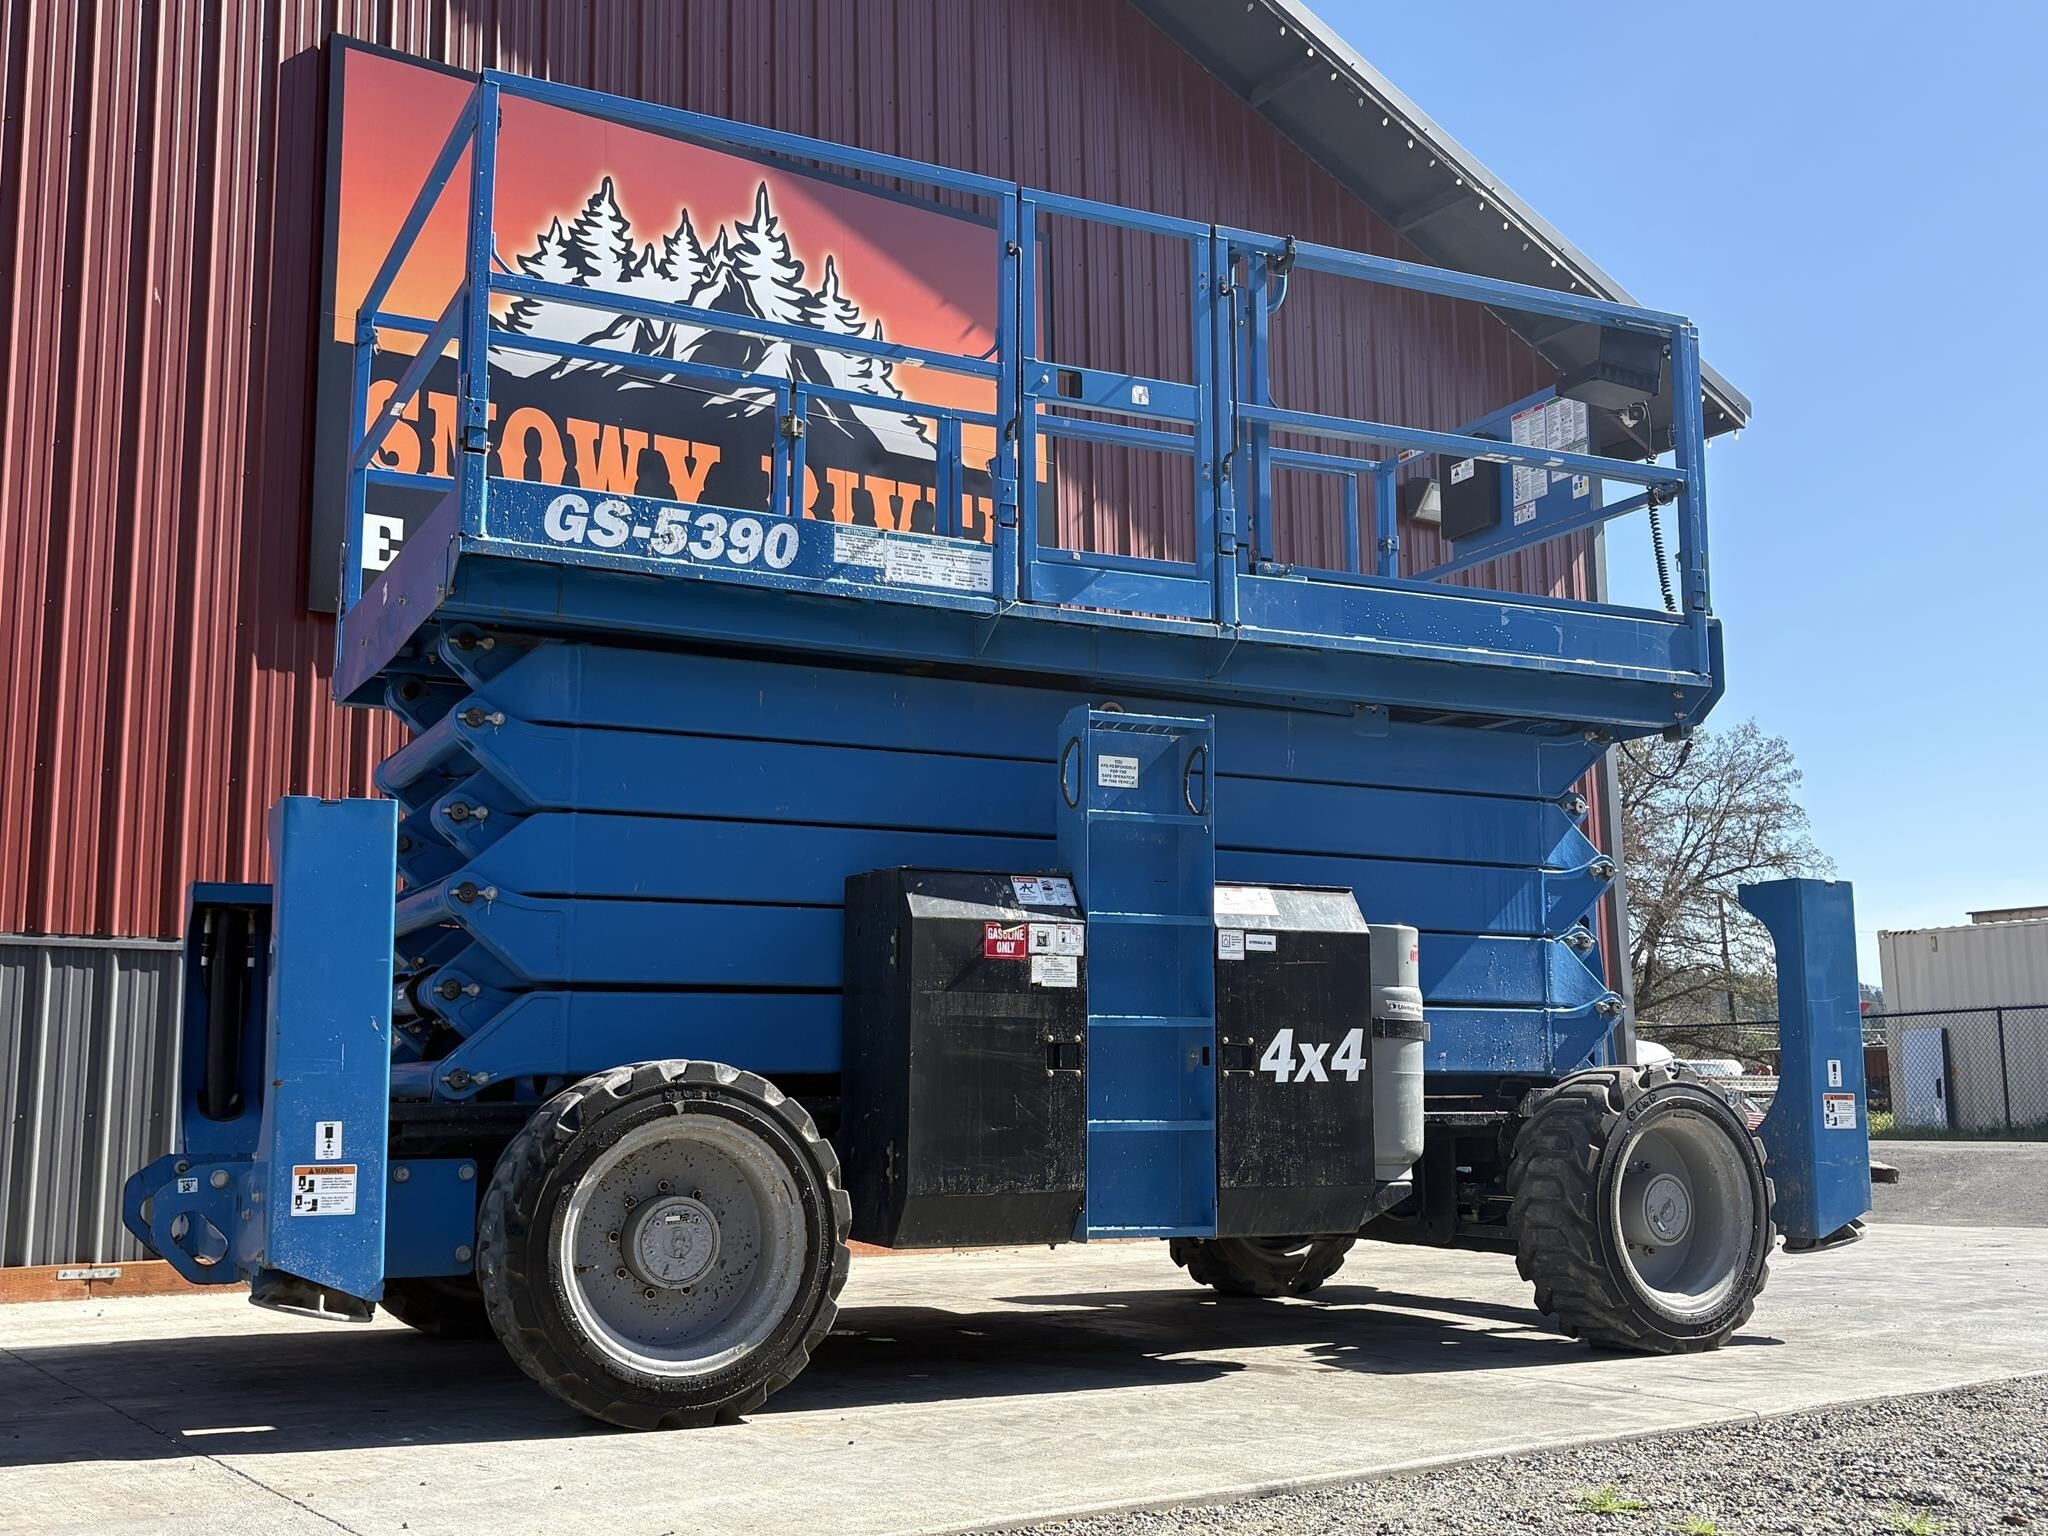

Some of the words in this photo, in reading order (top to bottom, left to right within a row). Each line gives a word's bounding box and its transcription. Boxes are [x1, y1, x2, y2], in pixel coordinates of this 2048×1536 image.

[543, 493, 800, 569] GS-5390
[987, 927, 1025, 941] GASOLINE
[996, 941, 1016, 954] ONLY
[1259, 1028, 1367, 1084] 4x4
